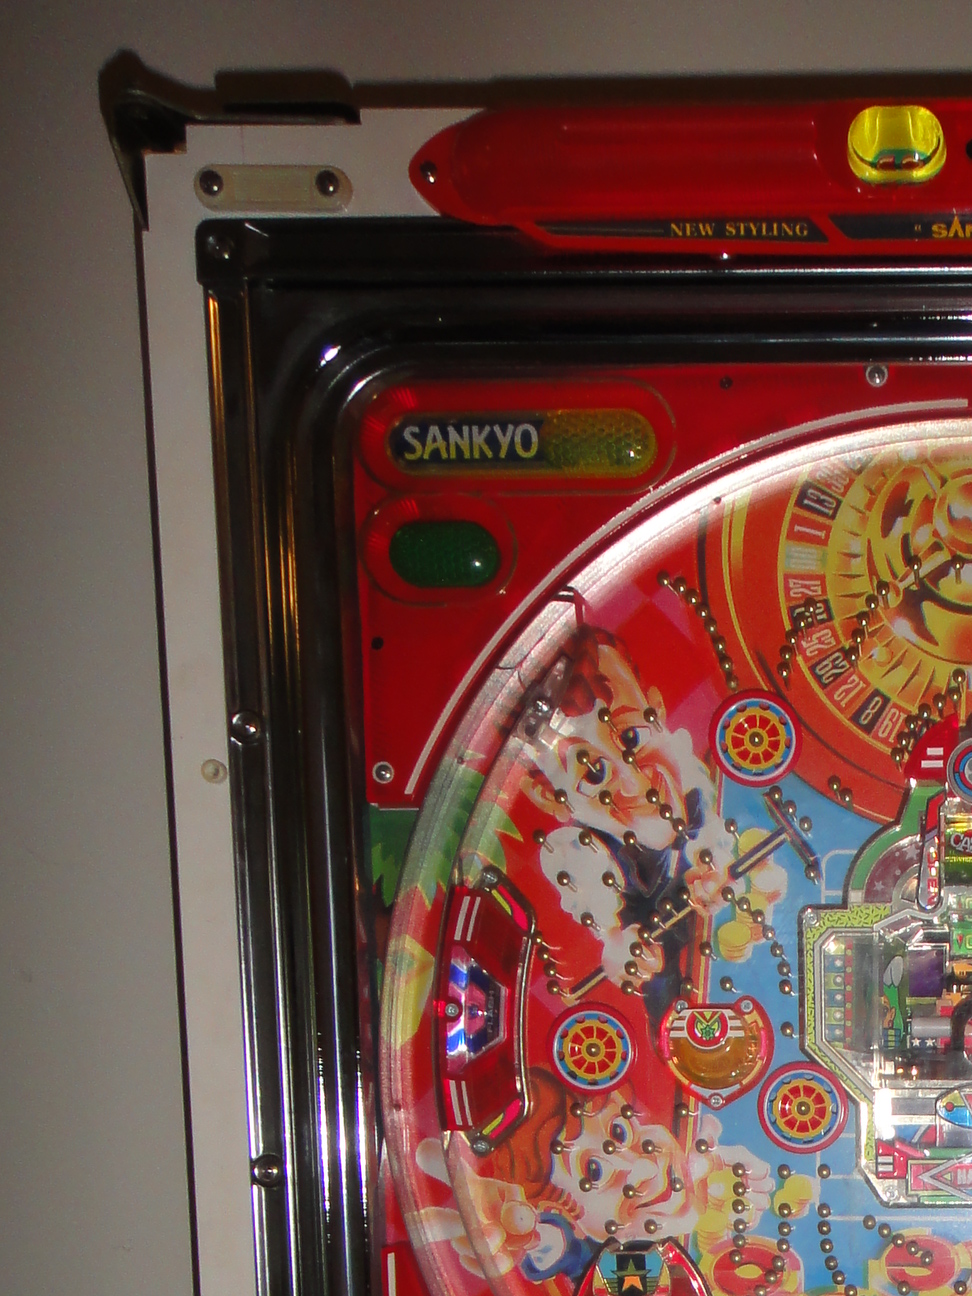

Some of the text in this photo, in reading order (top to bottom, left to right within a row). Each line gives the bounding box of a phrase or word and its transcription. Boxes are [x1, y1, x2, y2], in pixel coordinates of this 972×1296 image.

[670, 222, 808, 237] NEW STYLING
[403, 423, 539, 460] SANKYO
[802, 488, 836, 516] 13
[860, 696, 882, 725] 8
